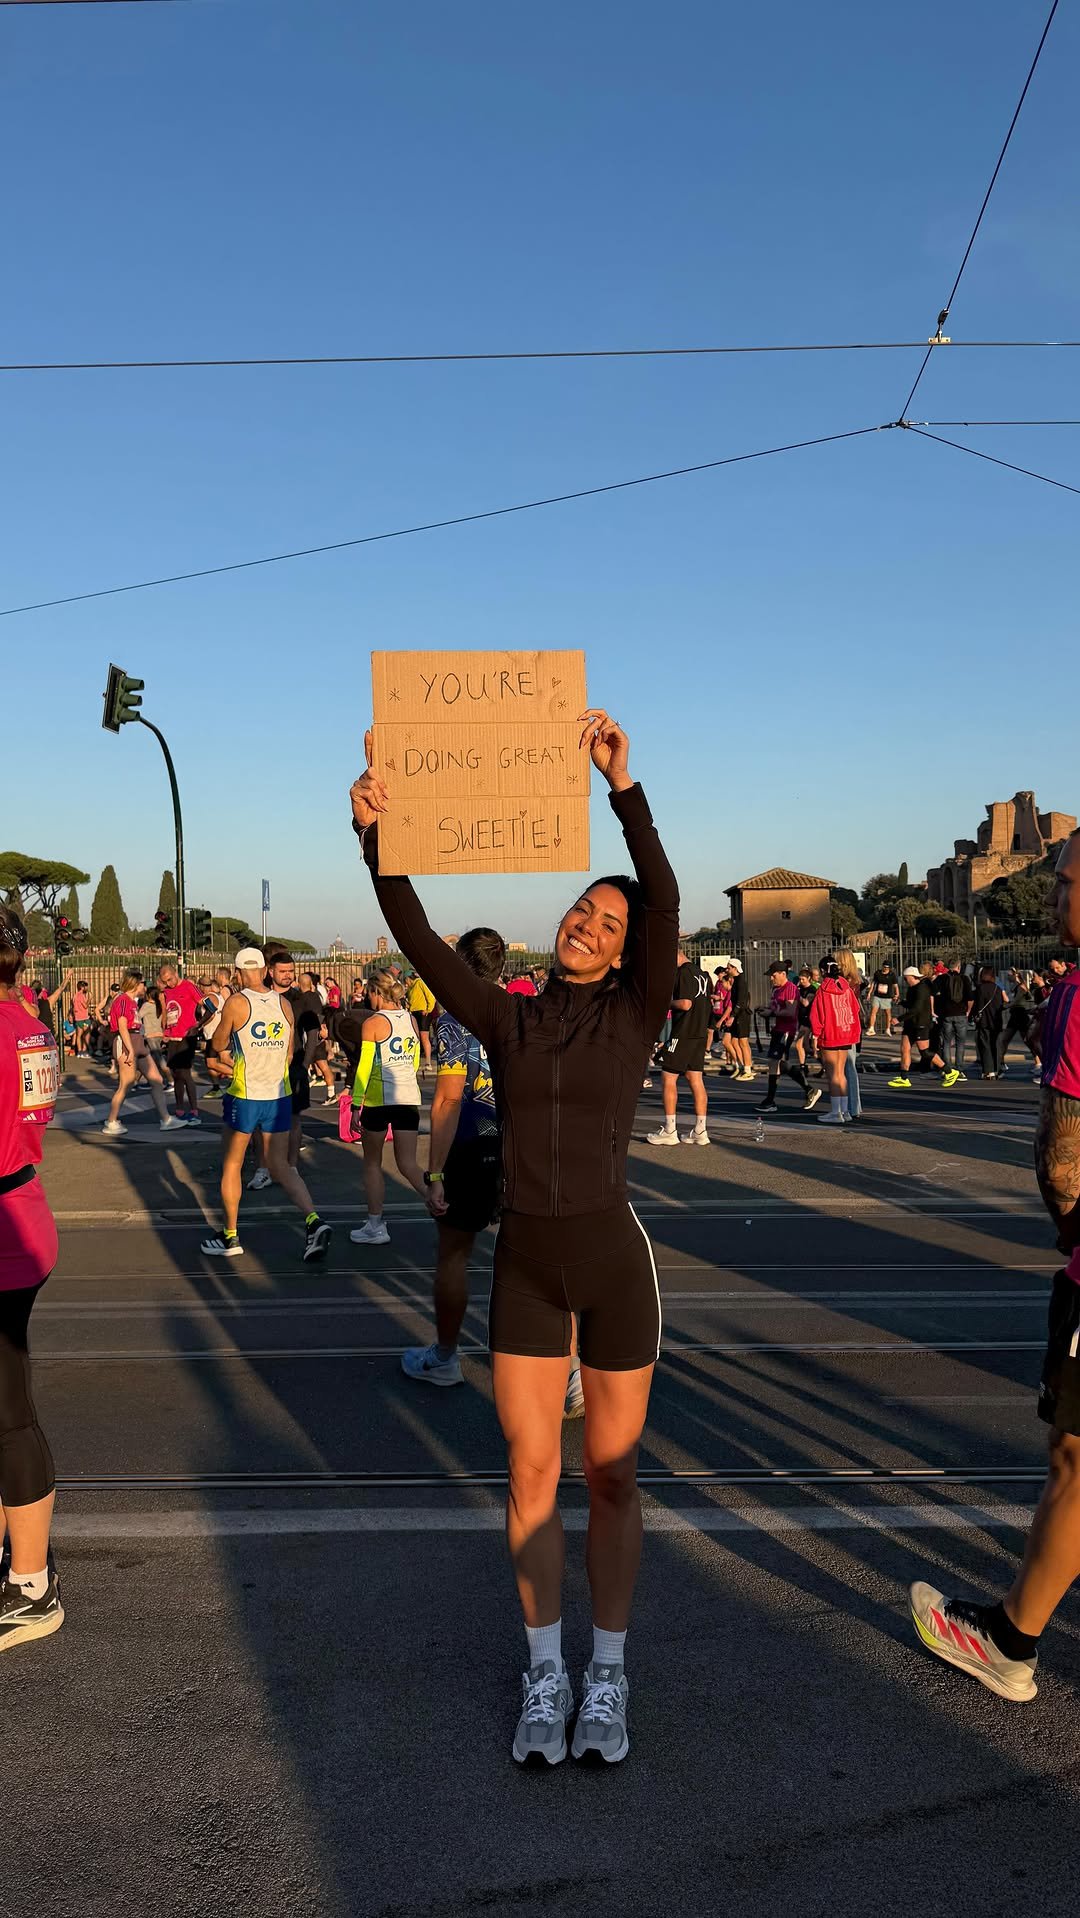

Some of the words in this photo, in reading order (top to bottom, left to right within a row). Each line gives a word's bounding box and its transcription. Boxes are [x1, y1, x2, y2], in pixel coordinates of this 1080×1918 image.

[420, 670, 535, 705] YOU'RE
[404, 748, 483, 778] DOING
[499, 746, 565, 769] GREAT
[438, 810, 562, 855] SWEETIE!
[250, 1040, 285, 1049] running
